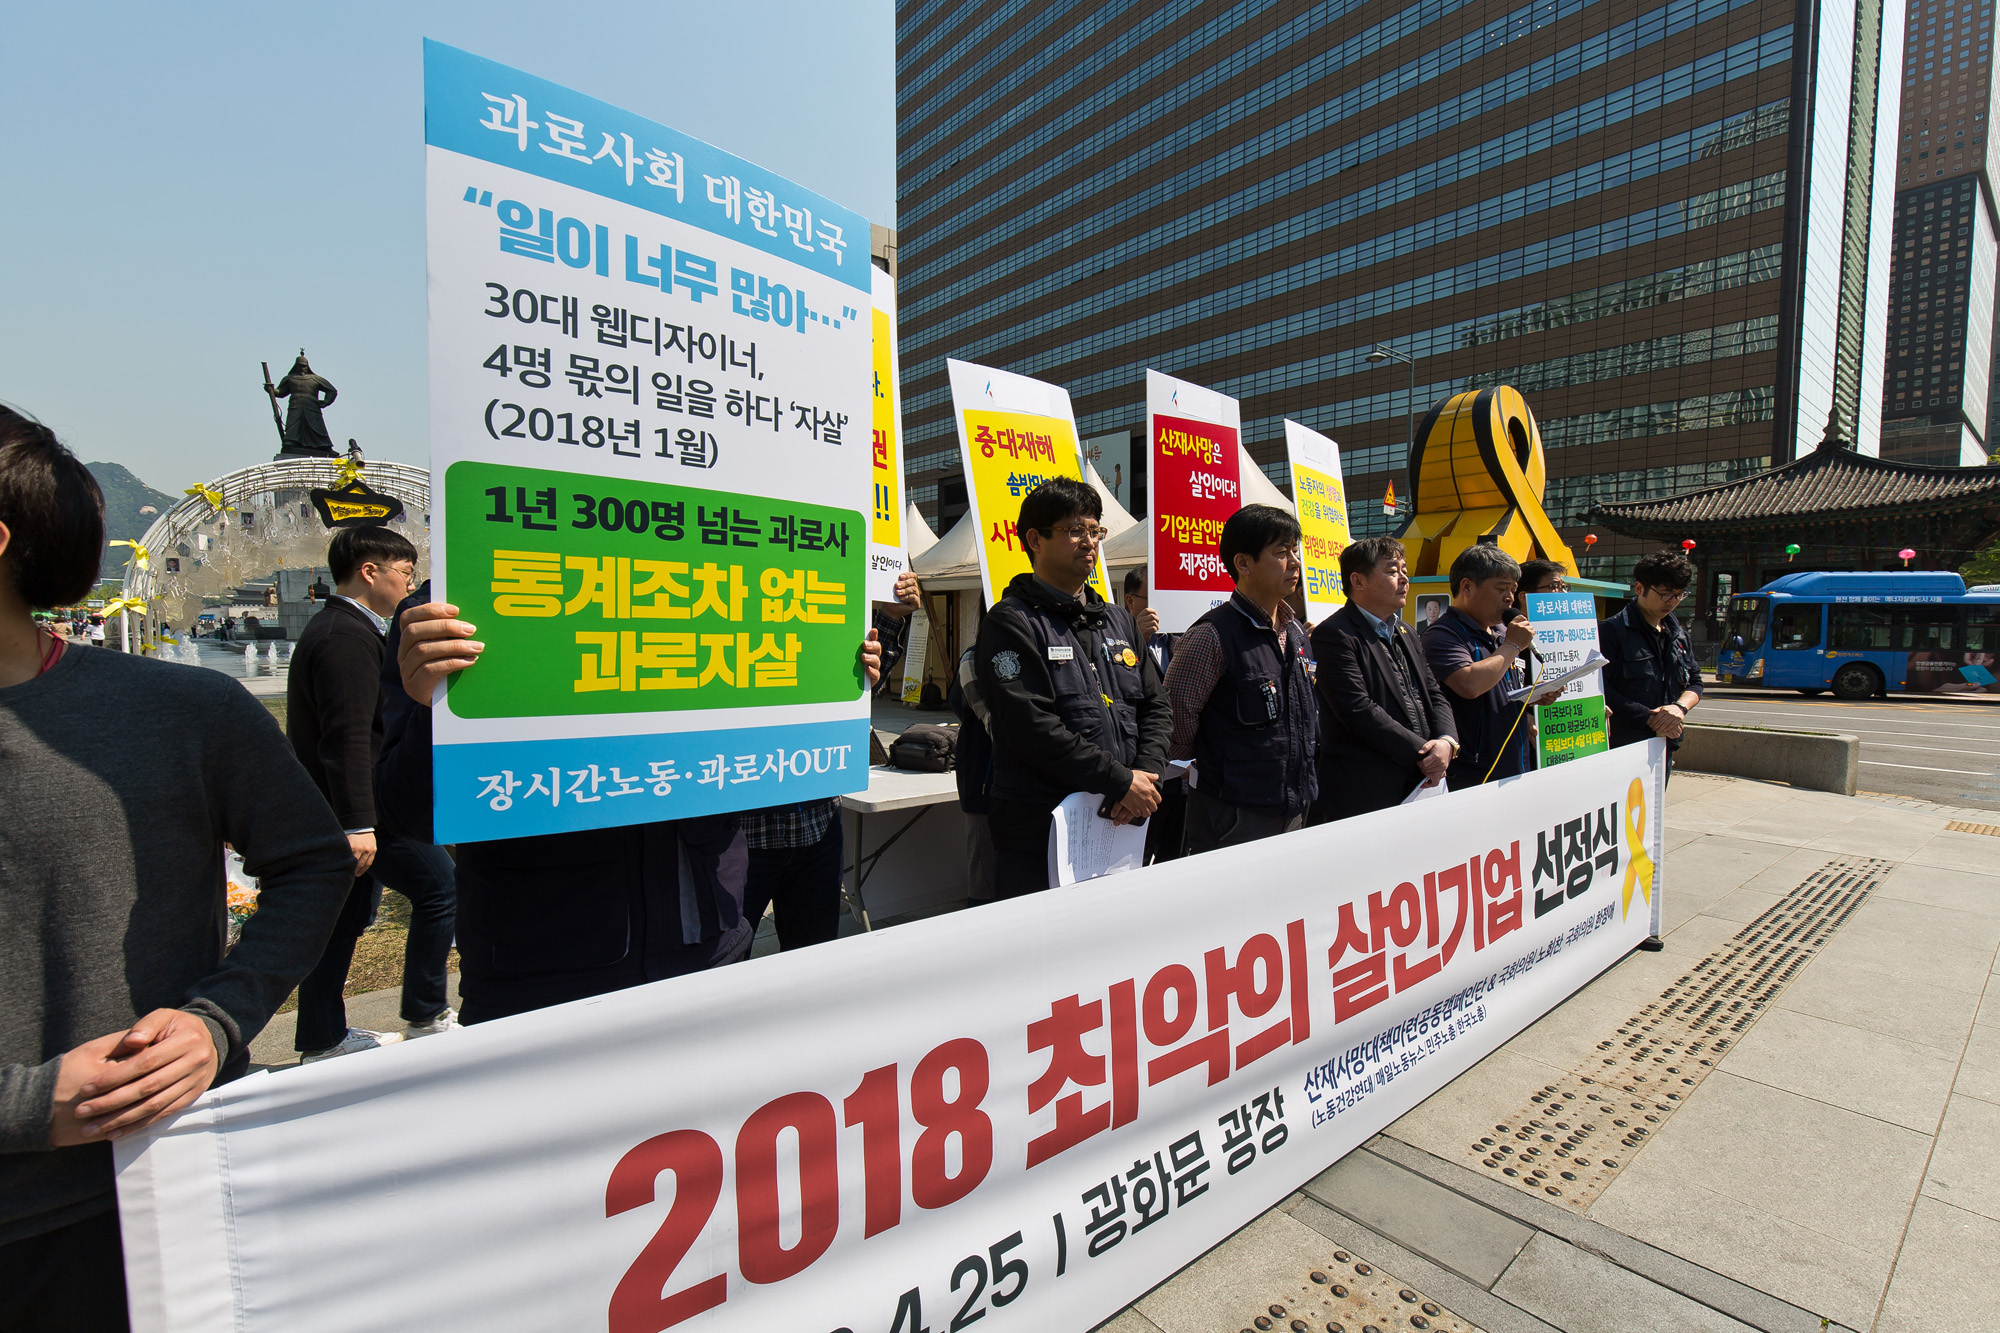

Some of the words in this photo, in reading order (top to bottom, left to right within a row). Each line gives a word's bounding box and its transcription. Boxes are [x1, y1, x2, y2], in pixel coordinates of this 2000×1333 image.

[480, 91, 684, 204] 과로사회
[703, 174, 847, 266] 대한민국
[625, 234, 718, 304] 너무
[484, 282, 578, 338] 30대
[591, 303, 764, 381] 웹디자이너,
[483, 344, 551, 389] 4명
[565, 353, 640, 405] 몫의
[652, 370, 717, 419] 일을
[724, 387, 783, 431] 하다
[484, 398, 641, 457] (2018년
[654, 428, 718, 469] 1월)
[975, 425, 1056, 464] 중대재해
[1159, 427, 1222, 465] 산재사망은
[1189, 470, 1237, 499] 살인이다!
[1299, 475, 1325, 498] 노동자의
[1301, 499, 1321, 519] 건강을
[485, 486, 557, 531] 1년
[571, 494, 685, 541] 300명
[697, 505, 761, 548] 넘는
[768, 514, 849, 557] 과로사
[1304, 534, 1327, 559] 위험의
[491, 549, 748, 622] 통계조차
[760, 567, 846, 624] 없는
[1537, 600, 1569, 616] 과로사회
[1571, 600, 1592, 614] 대한민국
[574, 631, 802, 693] 과로자살
[1543, 705, 1572, 719] 미국보다
[1573, 703, 1583, 716] 1달
[1544, 722, 1566, 735] OECD
[1567, 718, 1591, 734] 평균보다
[1545, 738, 1574, 753] 독일보다
[1575, 735, 1586, 748] 4달
[1303, 976, 1487, 1103] 산재사망대책마련공동캠페인단
[1487, 973, 1497, 992] &
[1499, 949, 1537, 986] 국회의원
[1566, 913, 1595, 946] 국회의원
[1594, 900, 1615, 930] 한정애
[605, 1037, 993, 1333] 2018
[1026, 918, 1310, 1170] 최악의
[1328, 840, 1523, 1025] 살인기업
[1532, 801, 1618, 920] 선정식
[1081, 1129, 1211, 1258] 광화문
[1218, 1086, 1288, 1176] 광장
